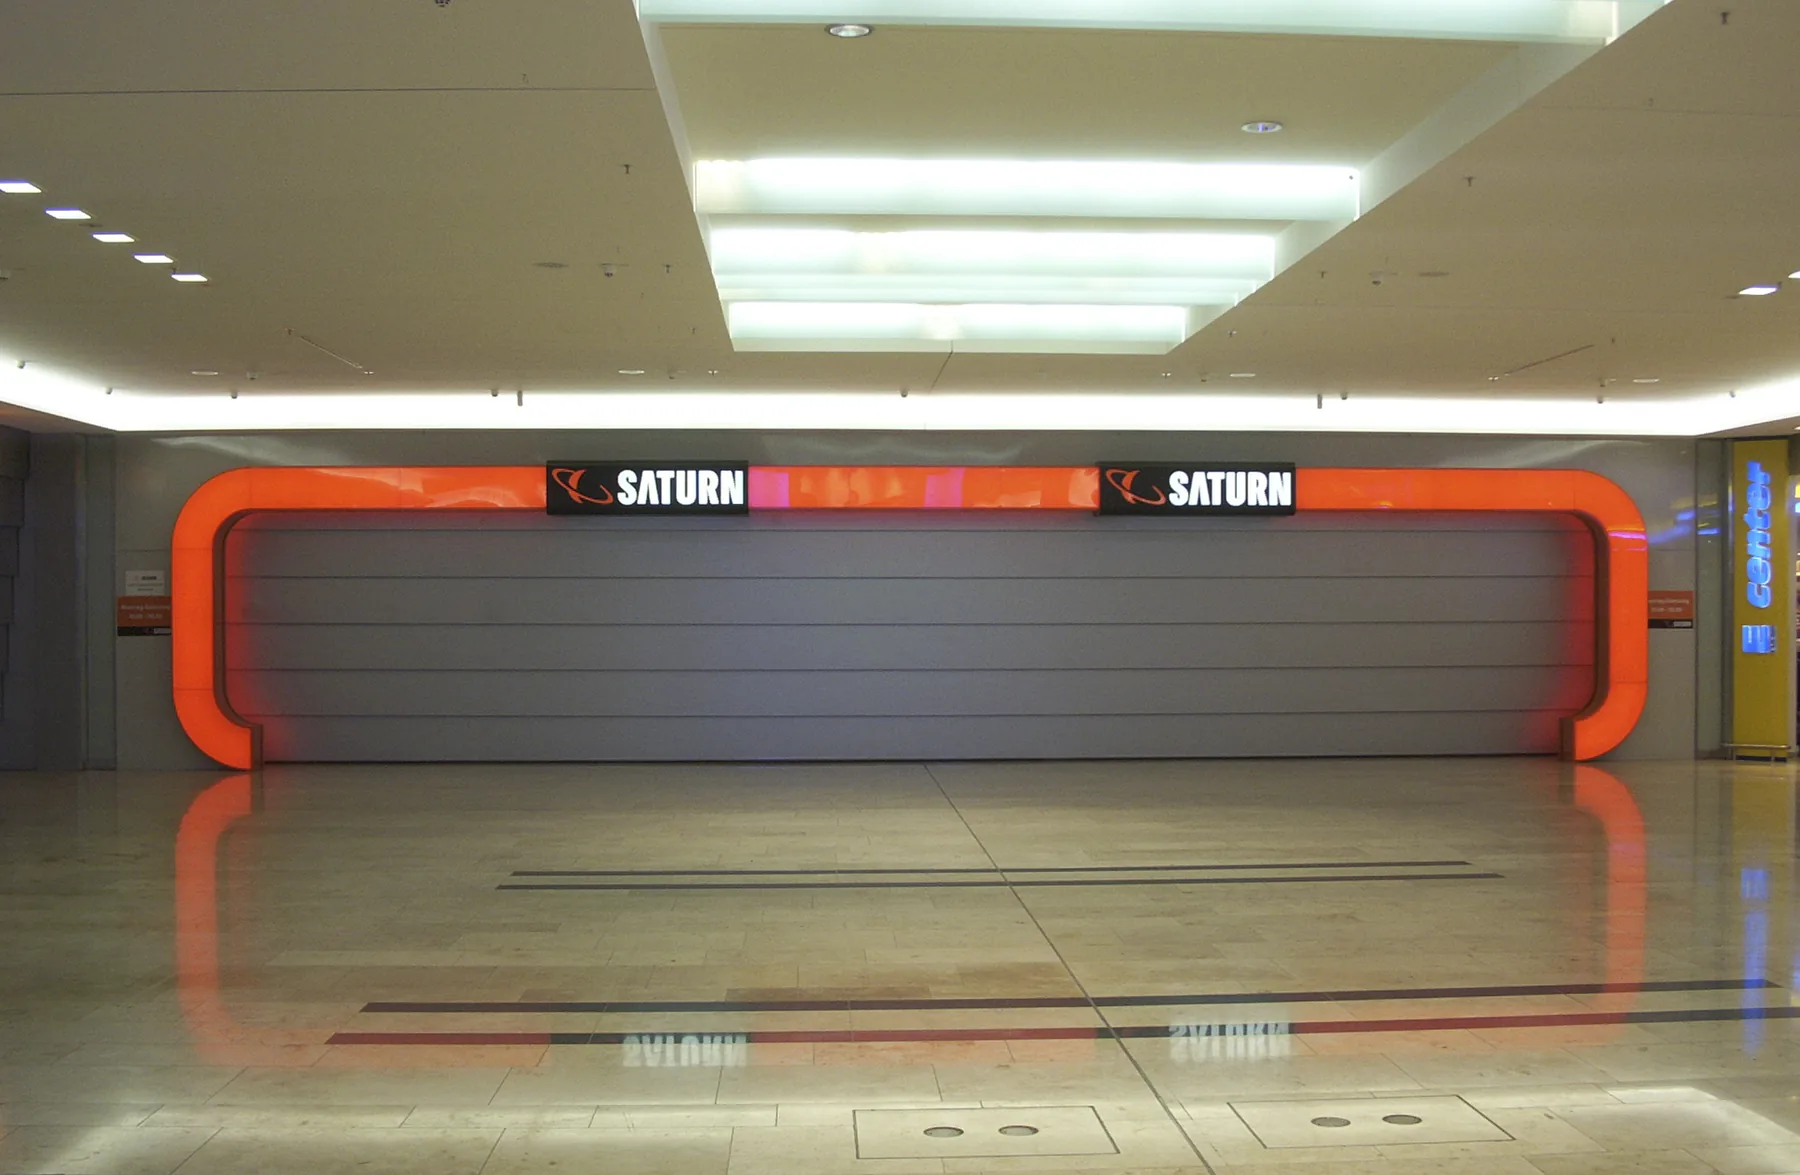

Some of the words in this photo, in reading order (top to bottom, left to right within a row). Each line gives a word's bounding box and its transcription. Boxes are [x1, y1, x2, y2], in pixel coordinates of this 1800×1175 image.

[617, 469, 744, 506] SATURN
[1169, 470, 1292, 507] SATURN
[1744, 461, 1772, 609] center
